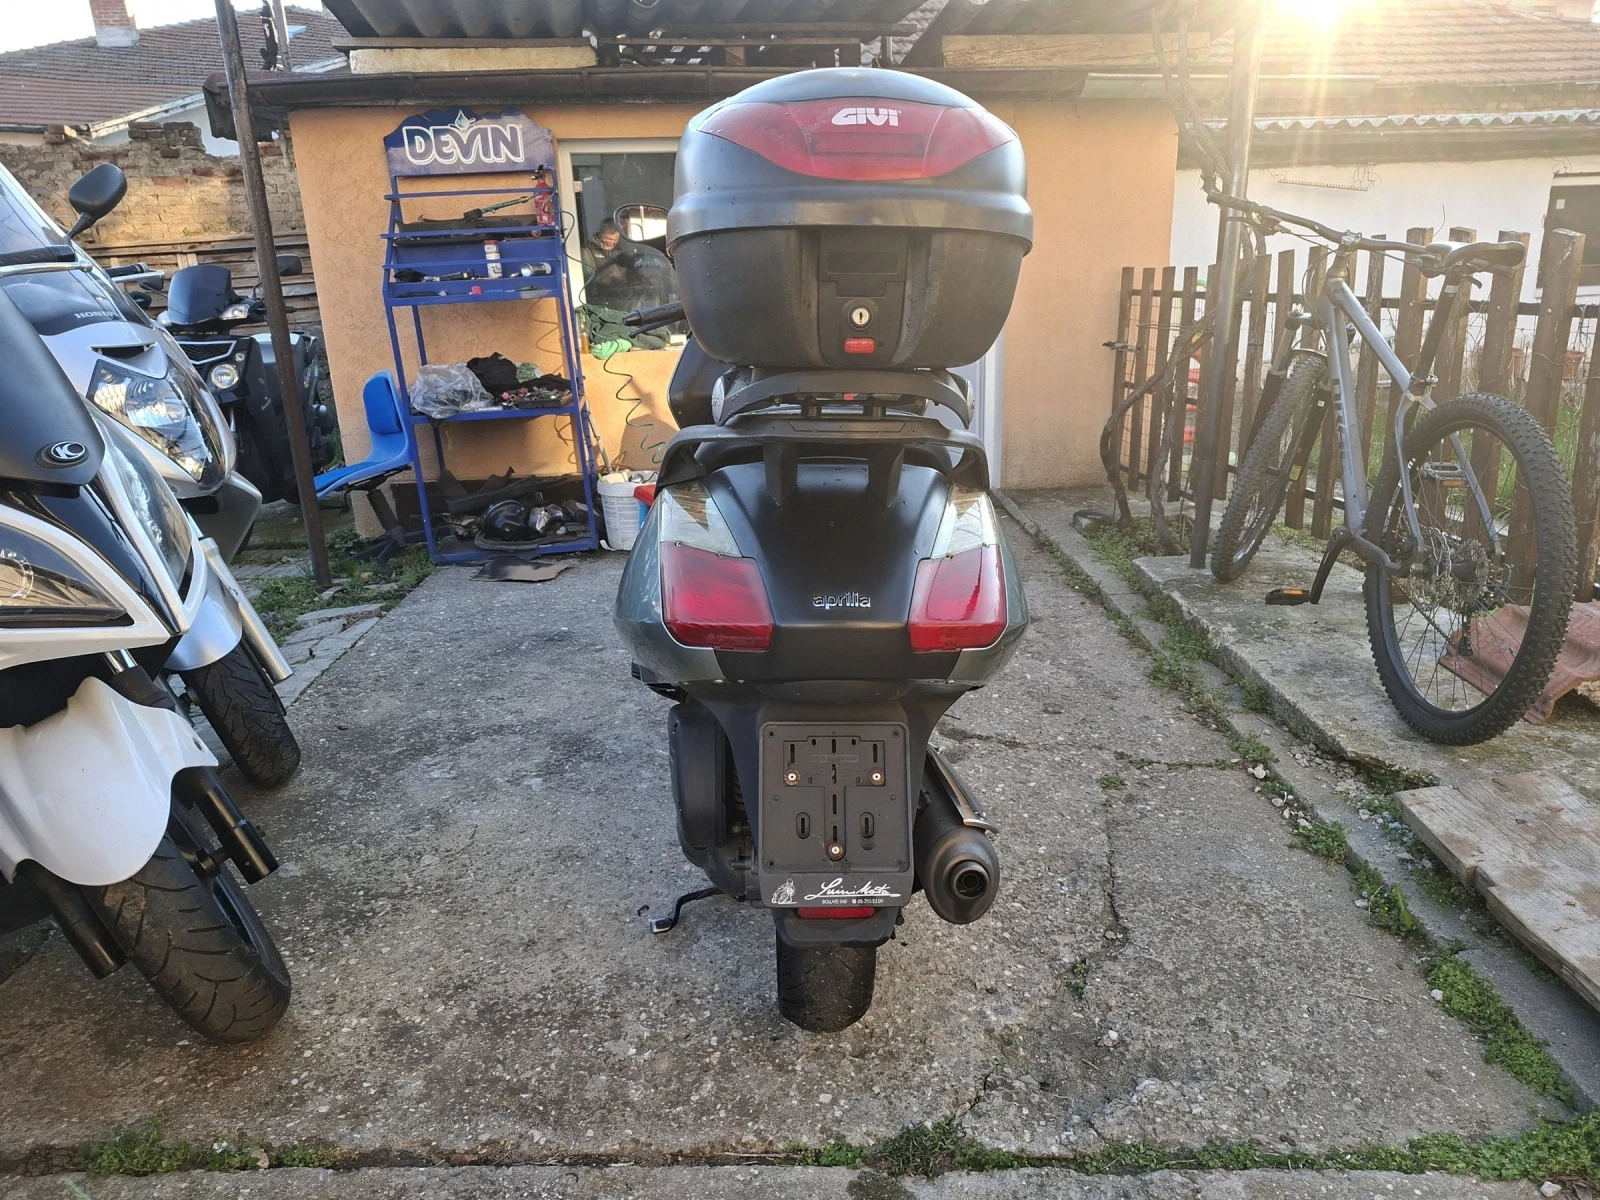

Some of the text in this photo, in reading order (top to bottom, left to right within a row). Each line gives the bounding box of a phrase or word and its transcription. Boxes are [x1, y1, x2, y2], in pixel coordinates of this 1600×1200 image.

[832, 107, 899, 126] GIVI
[402, 124, 525, 165] DEVIN
[812, 592, 871, 610] aprilia
